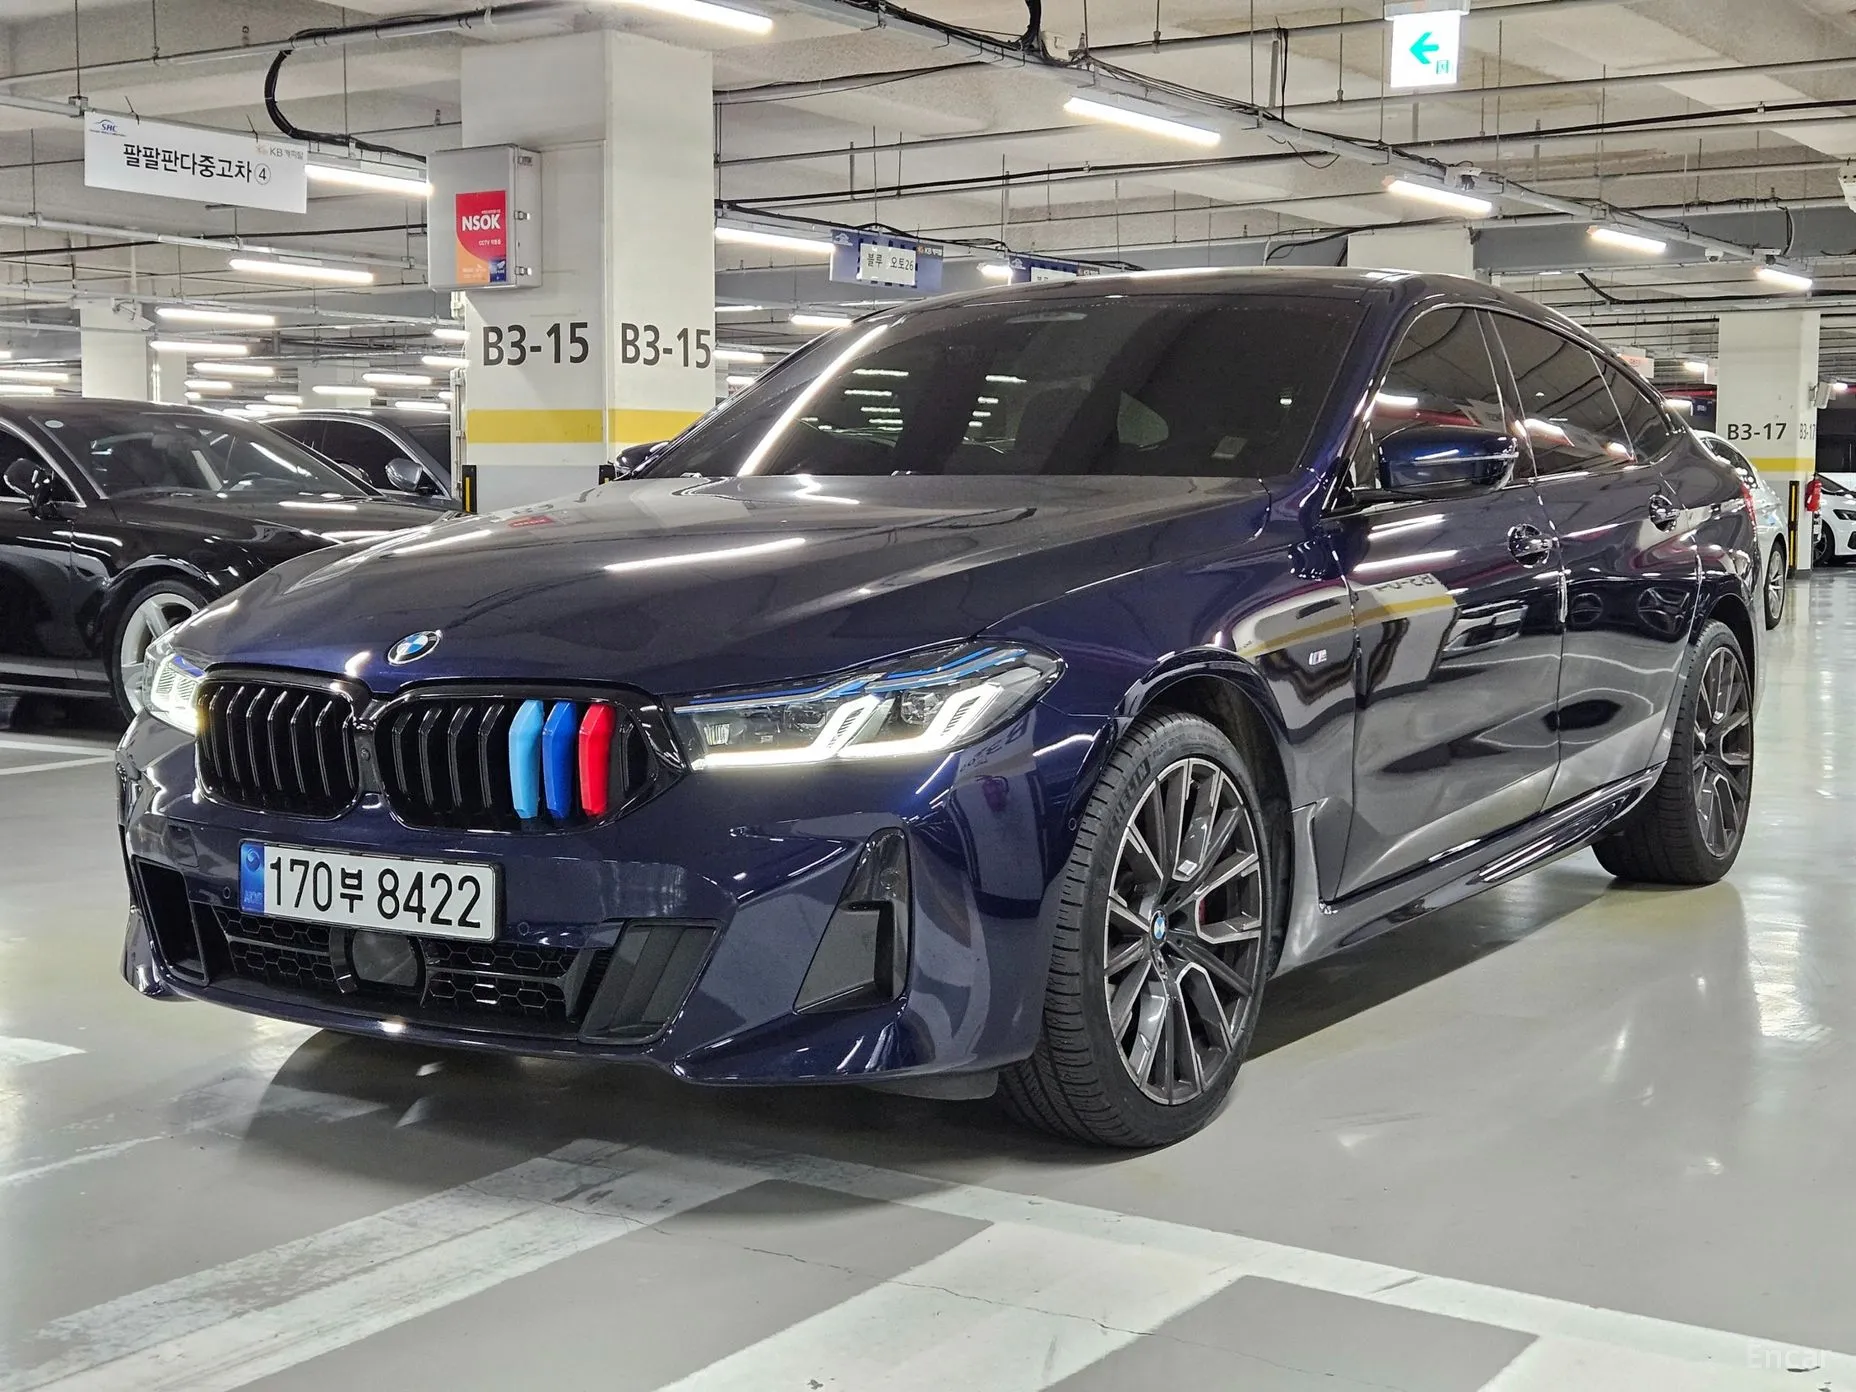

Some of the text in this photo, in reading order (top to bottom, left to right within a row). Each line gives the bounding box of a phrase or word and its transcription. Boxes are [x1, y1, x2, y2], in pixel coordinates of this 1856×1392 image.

[123, 143, 252, 183] 팔팔판다중고차
[270, 147, 283, 157] KB
[462, 213, 501, 231] NSOK
[890, 256, 914, 271] 오토26
[483, 322, 589, 366] B3-15
[621, 323, 711, 369] B3-15
[1727, 422, 1787, 441] B3-17
[269, 856, 482, 929] 170부 8422
